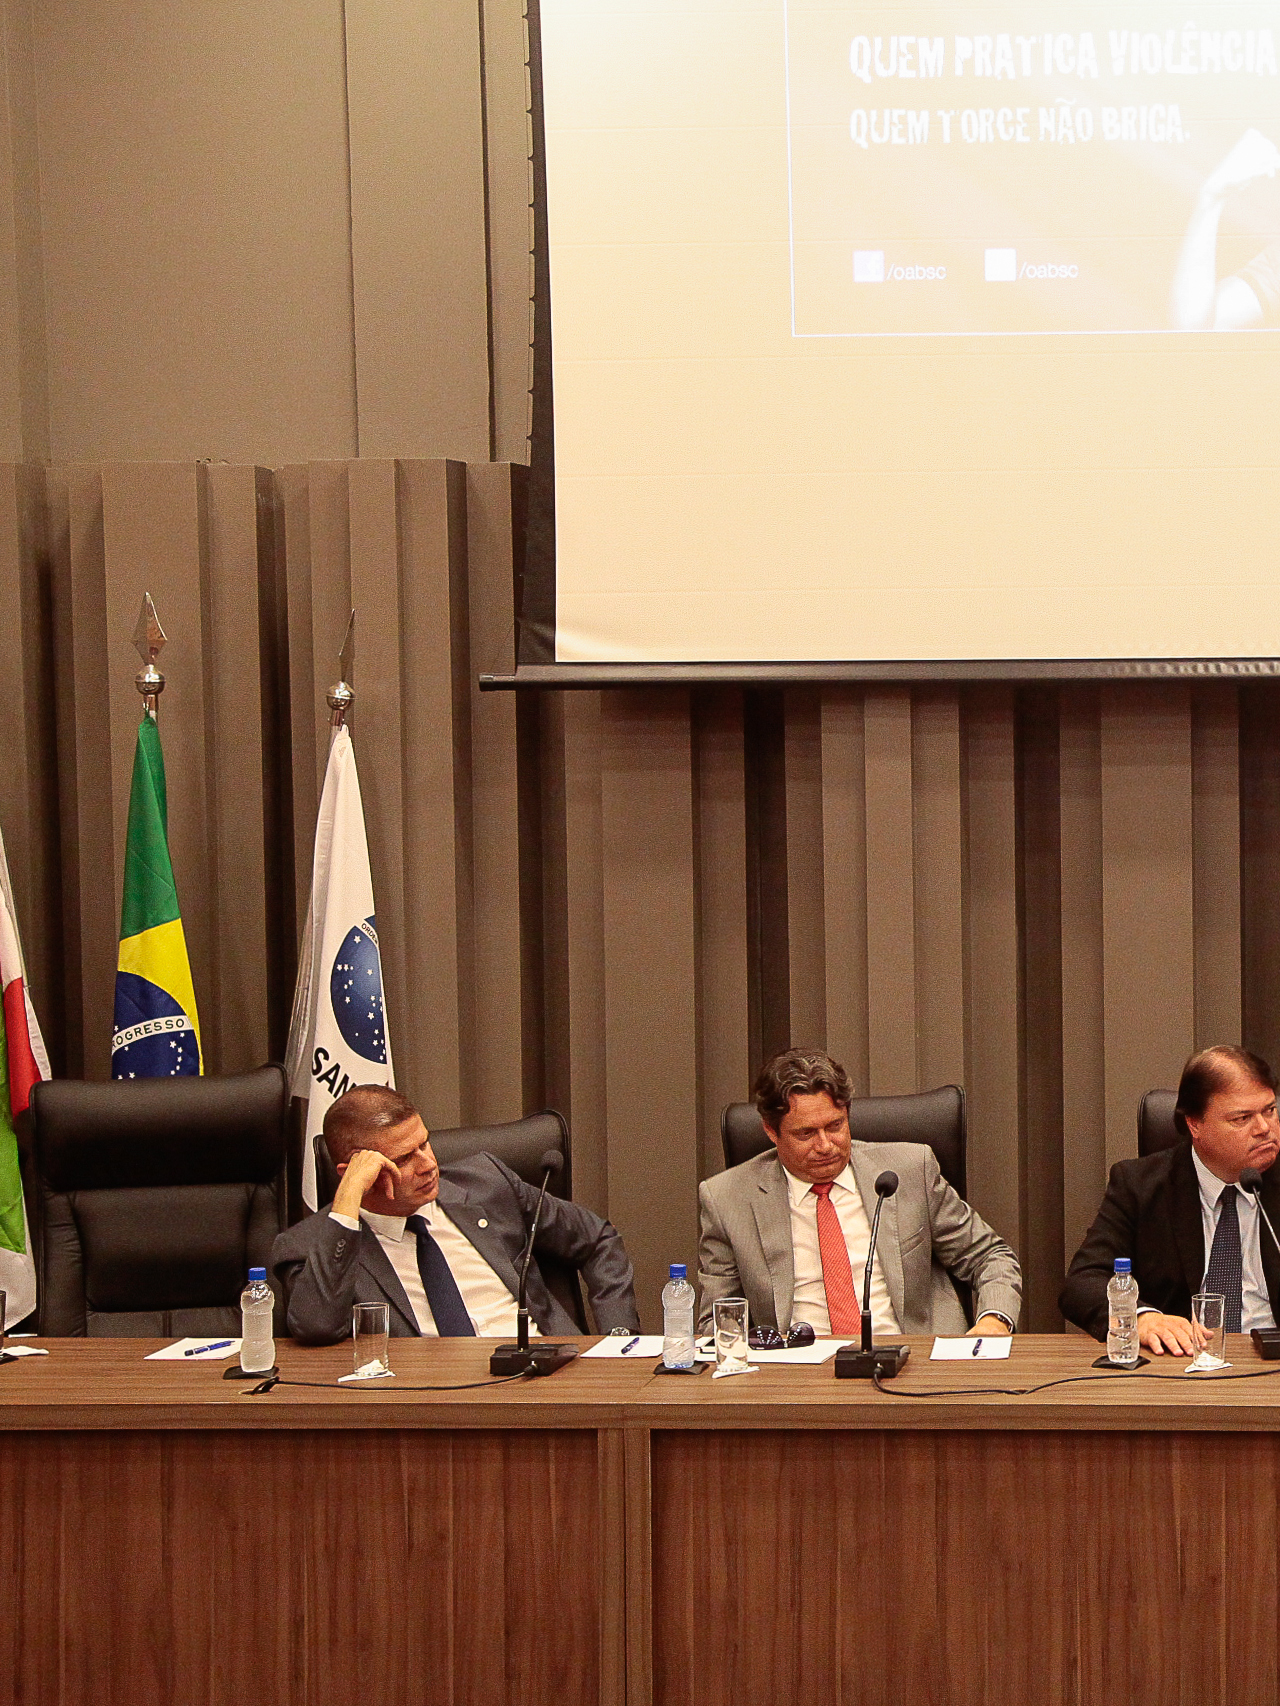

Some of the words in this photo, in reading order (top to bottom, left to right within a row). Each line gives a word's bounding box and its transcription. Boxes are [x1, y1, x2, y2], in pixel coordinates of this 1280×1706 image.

[849, 35, 945, 83] QUEM
[954, 32, 1099, 80] PRATICA
[1109, 21, 1278, 77] VIOLÊNCIA
[849, 107, 930, 148] QUEM
[937, 107, 1031, 144] TORCE
[1038, 97, 1094, 145] NÃO
[1101, 103, 1190, 144] BRIGA.
[887, 263, 947, 281] /oabsc
[1019, 261, 1079, 279] /oabsc
[361, 922, 379, 945] ORDE
[113, 1018, 185, 1048] OGRESSO
[312, 1046, 358, 1099] SAN
